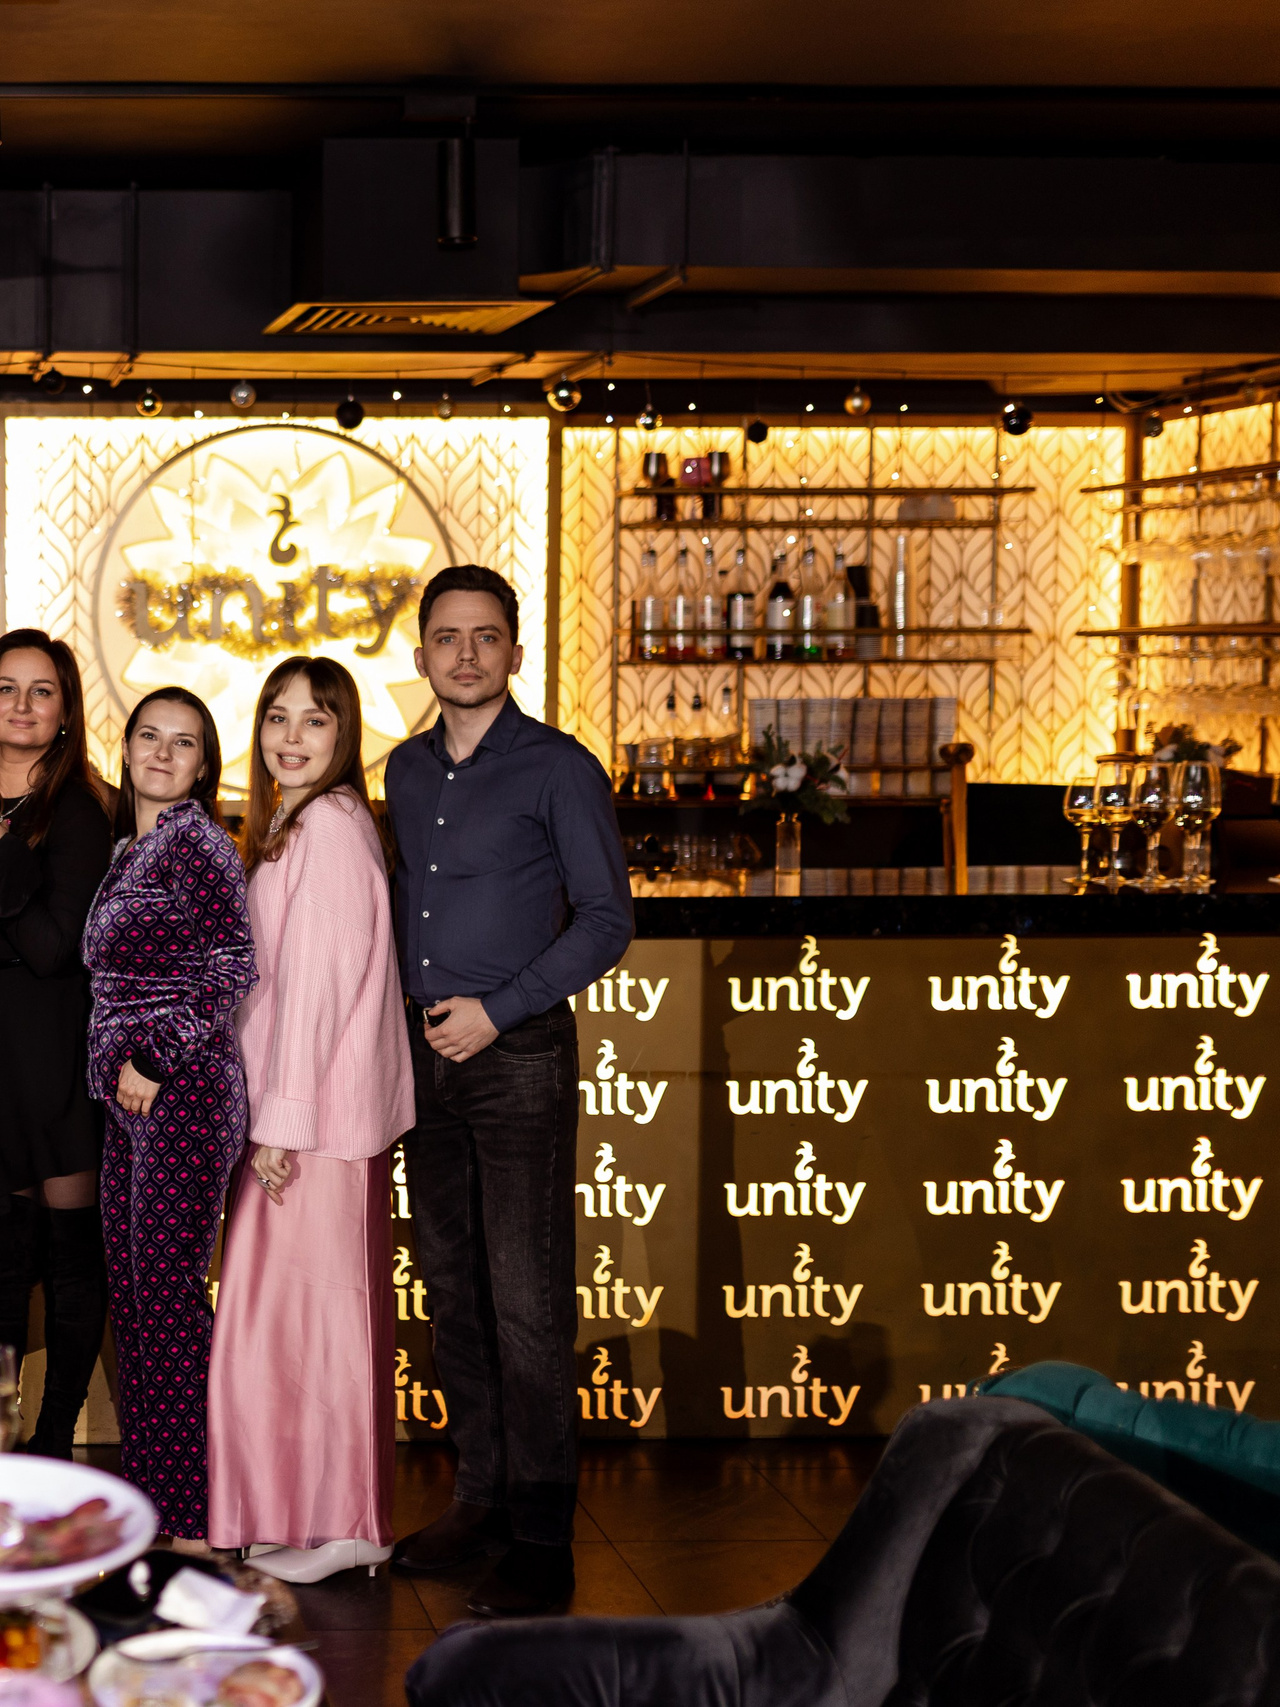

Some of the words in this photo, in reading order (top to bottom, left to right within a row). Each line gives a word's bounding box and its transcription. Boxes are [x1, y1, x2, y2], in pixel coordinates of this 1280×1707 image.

[126, 493, 418, 656] unity
[567, 966, 671, 1022] nity
[728, 935, 871, 1021] unity
[928, 933, 1071, 1019] unity
[1125, 932, 1270, 1018] unity
[578, 1038, 669, 1125] nity
[725, 1037, 869, 1123] unity
[925, 1036, 1068, 1122] unity
[1123, 1035, 1267, 1120] unity
[574, 1142, 667, 1227] nity
[723, 1140, 867, 1225] unity
[922, 1138, 1066, 1223] unity
[1120, 1136, 1264, 1221] unity
[576, 1244, 664, 1328] nity
[722, 1243, 864, 1326] unity
[921, 1240, 1062, 1324] unity
[1118, 1239, 1260, 1322] unity
[394, 1348, 449, 1430] ity
[576, 1347, 662, 1428] ity
[721, 1345, 861, 1426] unity
